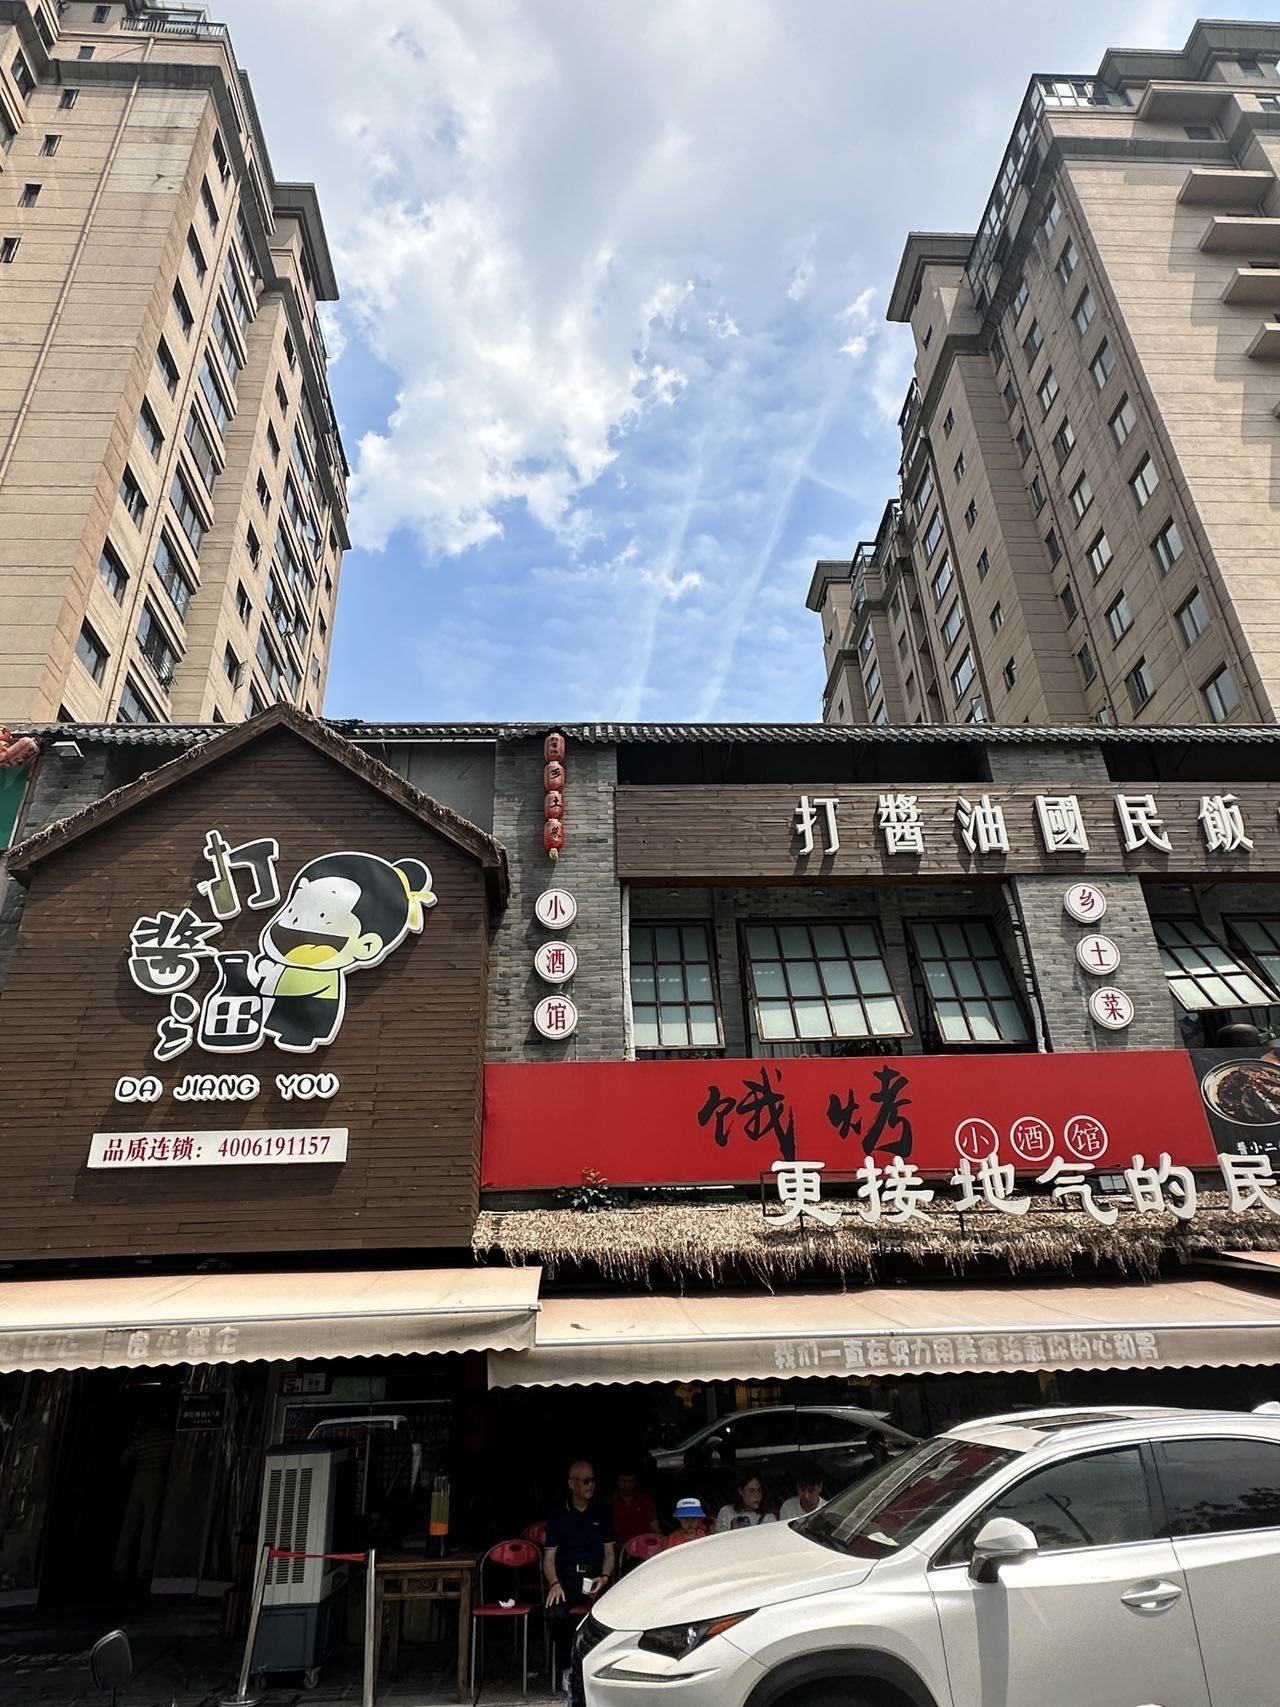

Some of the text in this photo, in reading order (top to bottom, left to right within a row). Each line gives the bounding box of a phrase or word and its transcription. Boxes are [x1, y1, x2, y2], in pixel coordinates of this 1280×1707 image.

[795, 792, 1254, 856] 打醬油國民飯
[544, 893, 568, 1032] 小酒馆
[1077, 886, 1125, 1021] 乡土菜
[115, 1072, 340, 1102] DA JIANG YOU
[698, 1064, 914, 1160] 饿烤
[217, 1135, 331, 1159] 4006191157
[962, 1121, 1102, 1155] 小酒馆
[764, 1151, 1280, 1226] 更接地气的民
